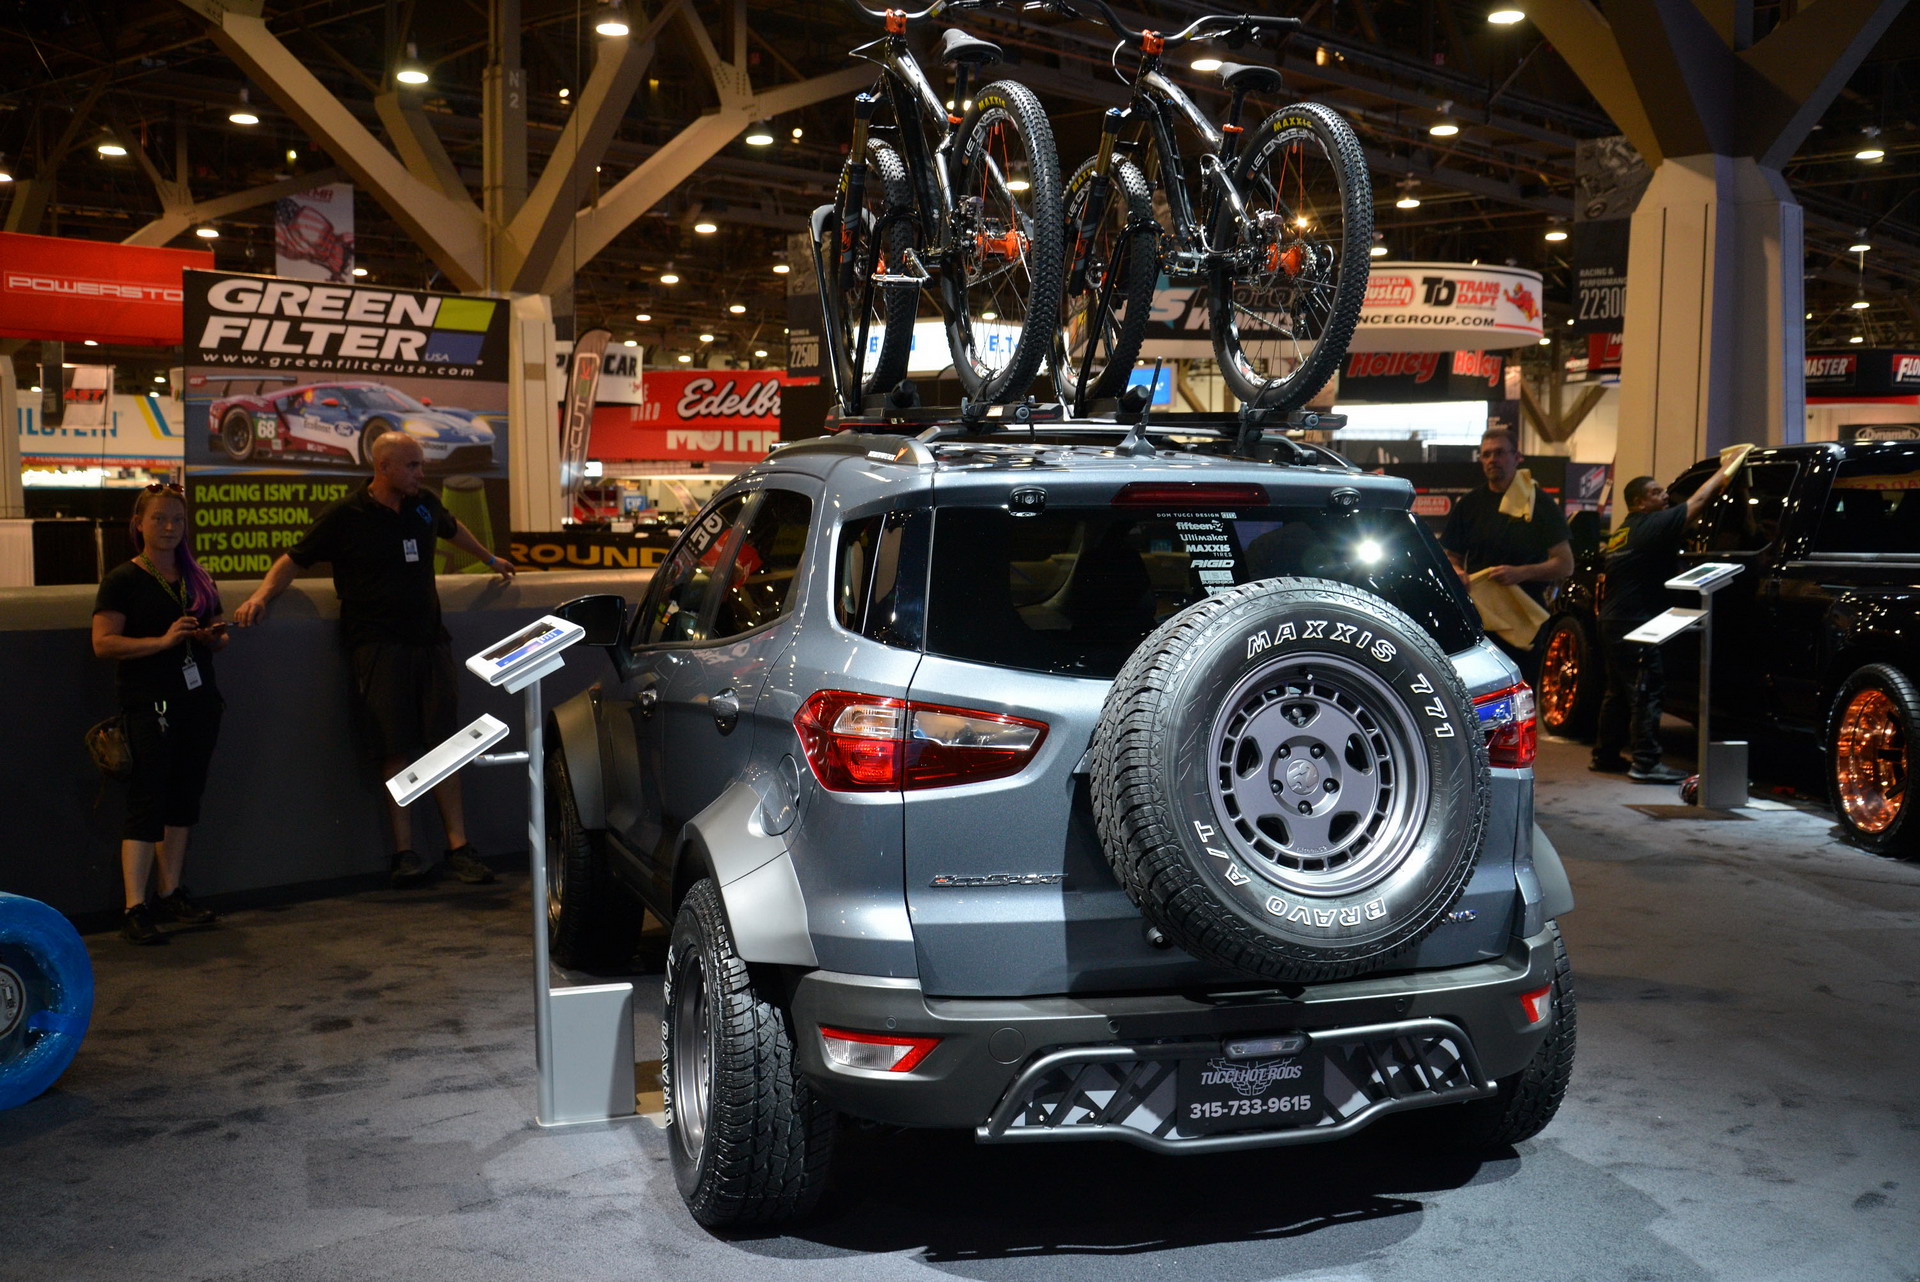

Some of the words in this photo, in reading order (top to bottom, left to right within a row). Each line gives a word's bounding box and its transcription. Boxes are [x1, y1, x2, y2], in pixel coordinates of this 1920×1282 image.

[1273, 117, 1313, 132] MAXXIS
[1456, 279, 1500, 296] TRANS
[207, 278, 442, 327] GREEN
[1457, 294, 1498, 307] DAPT
[199, 315, 427, 361] FILTER
[202, 352, 475, 378] www.greenfilterusa.com
[424, 352, 449, 363] USA
[790, 343, 819, 368] 22500
[1347, 350, 1441, 384] Holley
[1452, 349, 1502, 387] Holley
[1895, 357, 1920, 383] FLO
[677, 378, 781, 419] Edelbr
[257, 420, 276, 438] 68
[195, 484, 261, 502] RACING
[264, 483, 307, 500] ISN'T
[309, 484, 348, 500] JUST
[195, 508, 233, 526] OUR
[237, 507, 314, 526] PASSION.
[196, 532, 228, 550] IT'S
[231, 531, 268, 549] OUR
[1186, 544, 1231, 552] MAXXIS
[1190, 559, 1235, 568] RIGID
[1246, 619, 1398, 664] MAXXIS
[1410, 672, 1456, 739] 771
[1193, 820, 1252, 887] A/T
[1265, 895, 1388, 928] BRAVO
[1201, 1071, 1238, 1085] TUCCI
[1242, 1069, 1266, 1083] HOT
[1267, 1065, 1302, 1080] RODS
[1189, 1095, 1312, 1119] 315-733-9615
